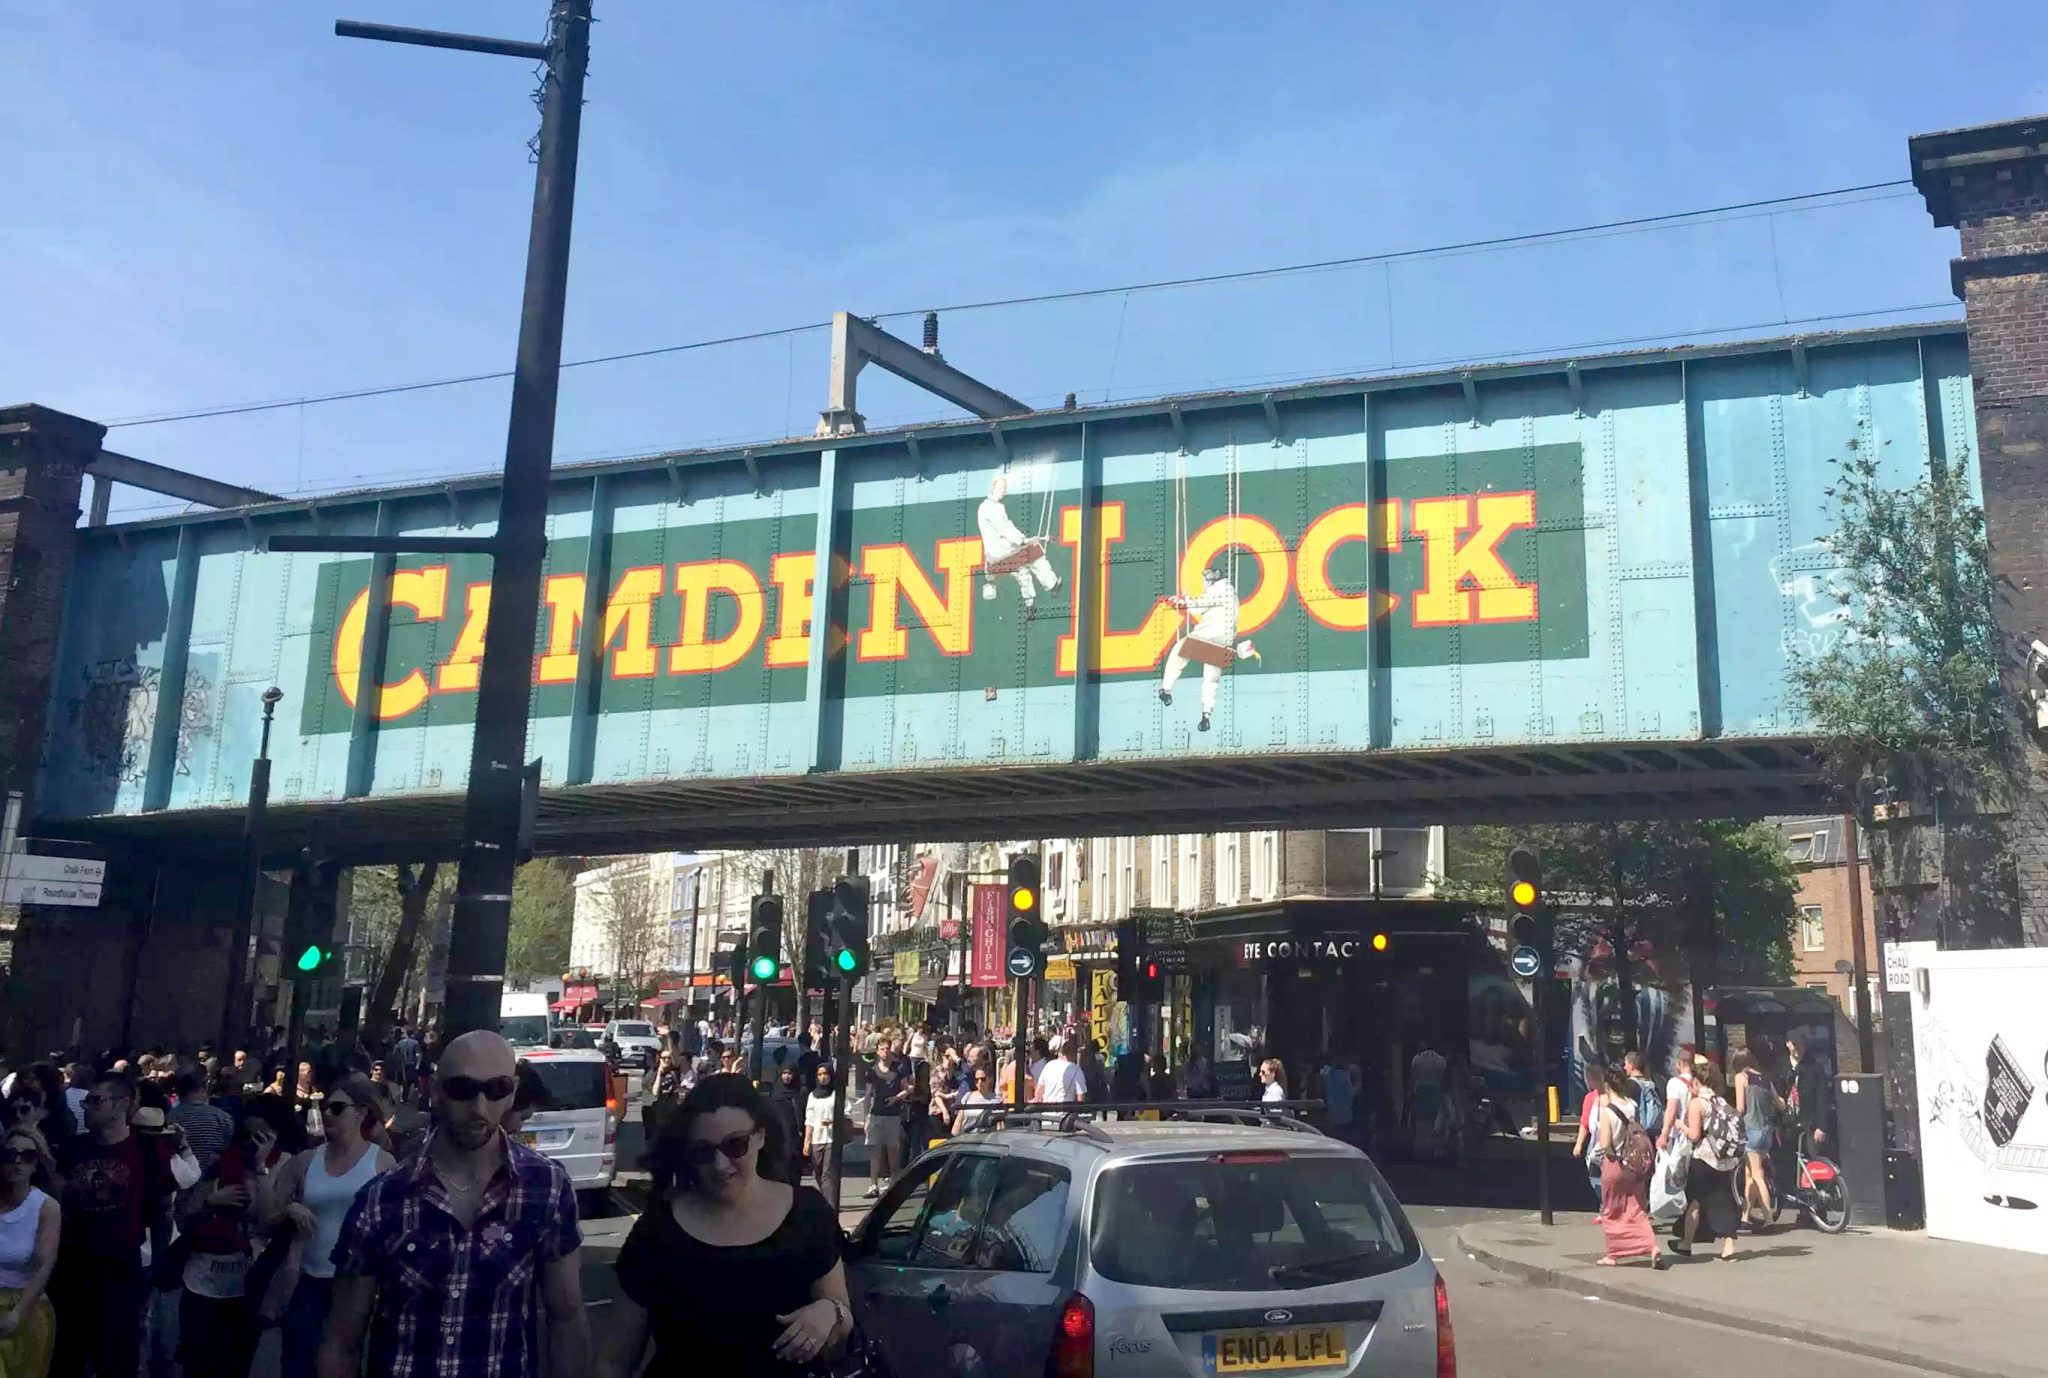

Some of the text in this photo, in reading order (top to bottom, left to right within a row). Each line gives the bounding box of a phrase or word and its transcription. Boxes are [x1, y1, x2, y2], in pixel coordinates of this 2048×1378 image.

[332, 490, 1537, 721] CAMDEN LOCK
[984, 929, 994, 971] CHIPS
[1244, 941, 1360, 959] EYE CONTAC
[1888, 973, 1910, 985] ROAD
[1222, 1327, 1341, 1366] EN04 LFL
